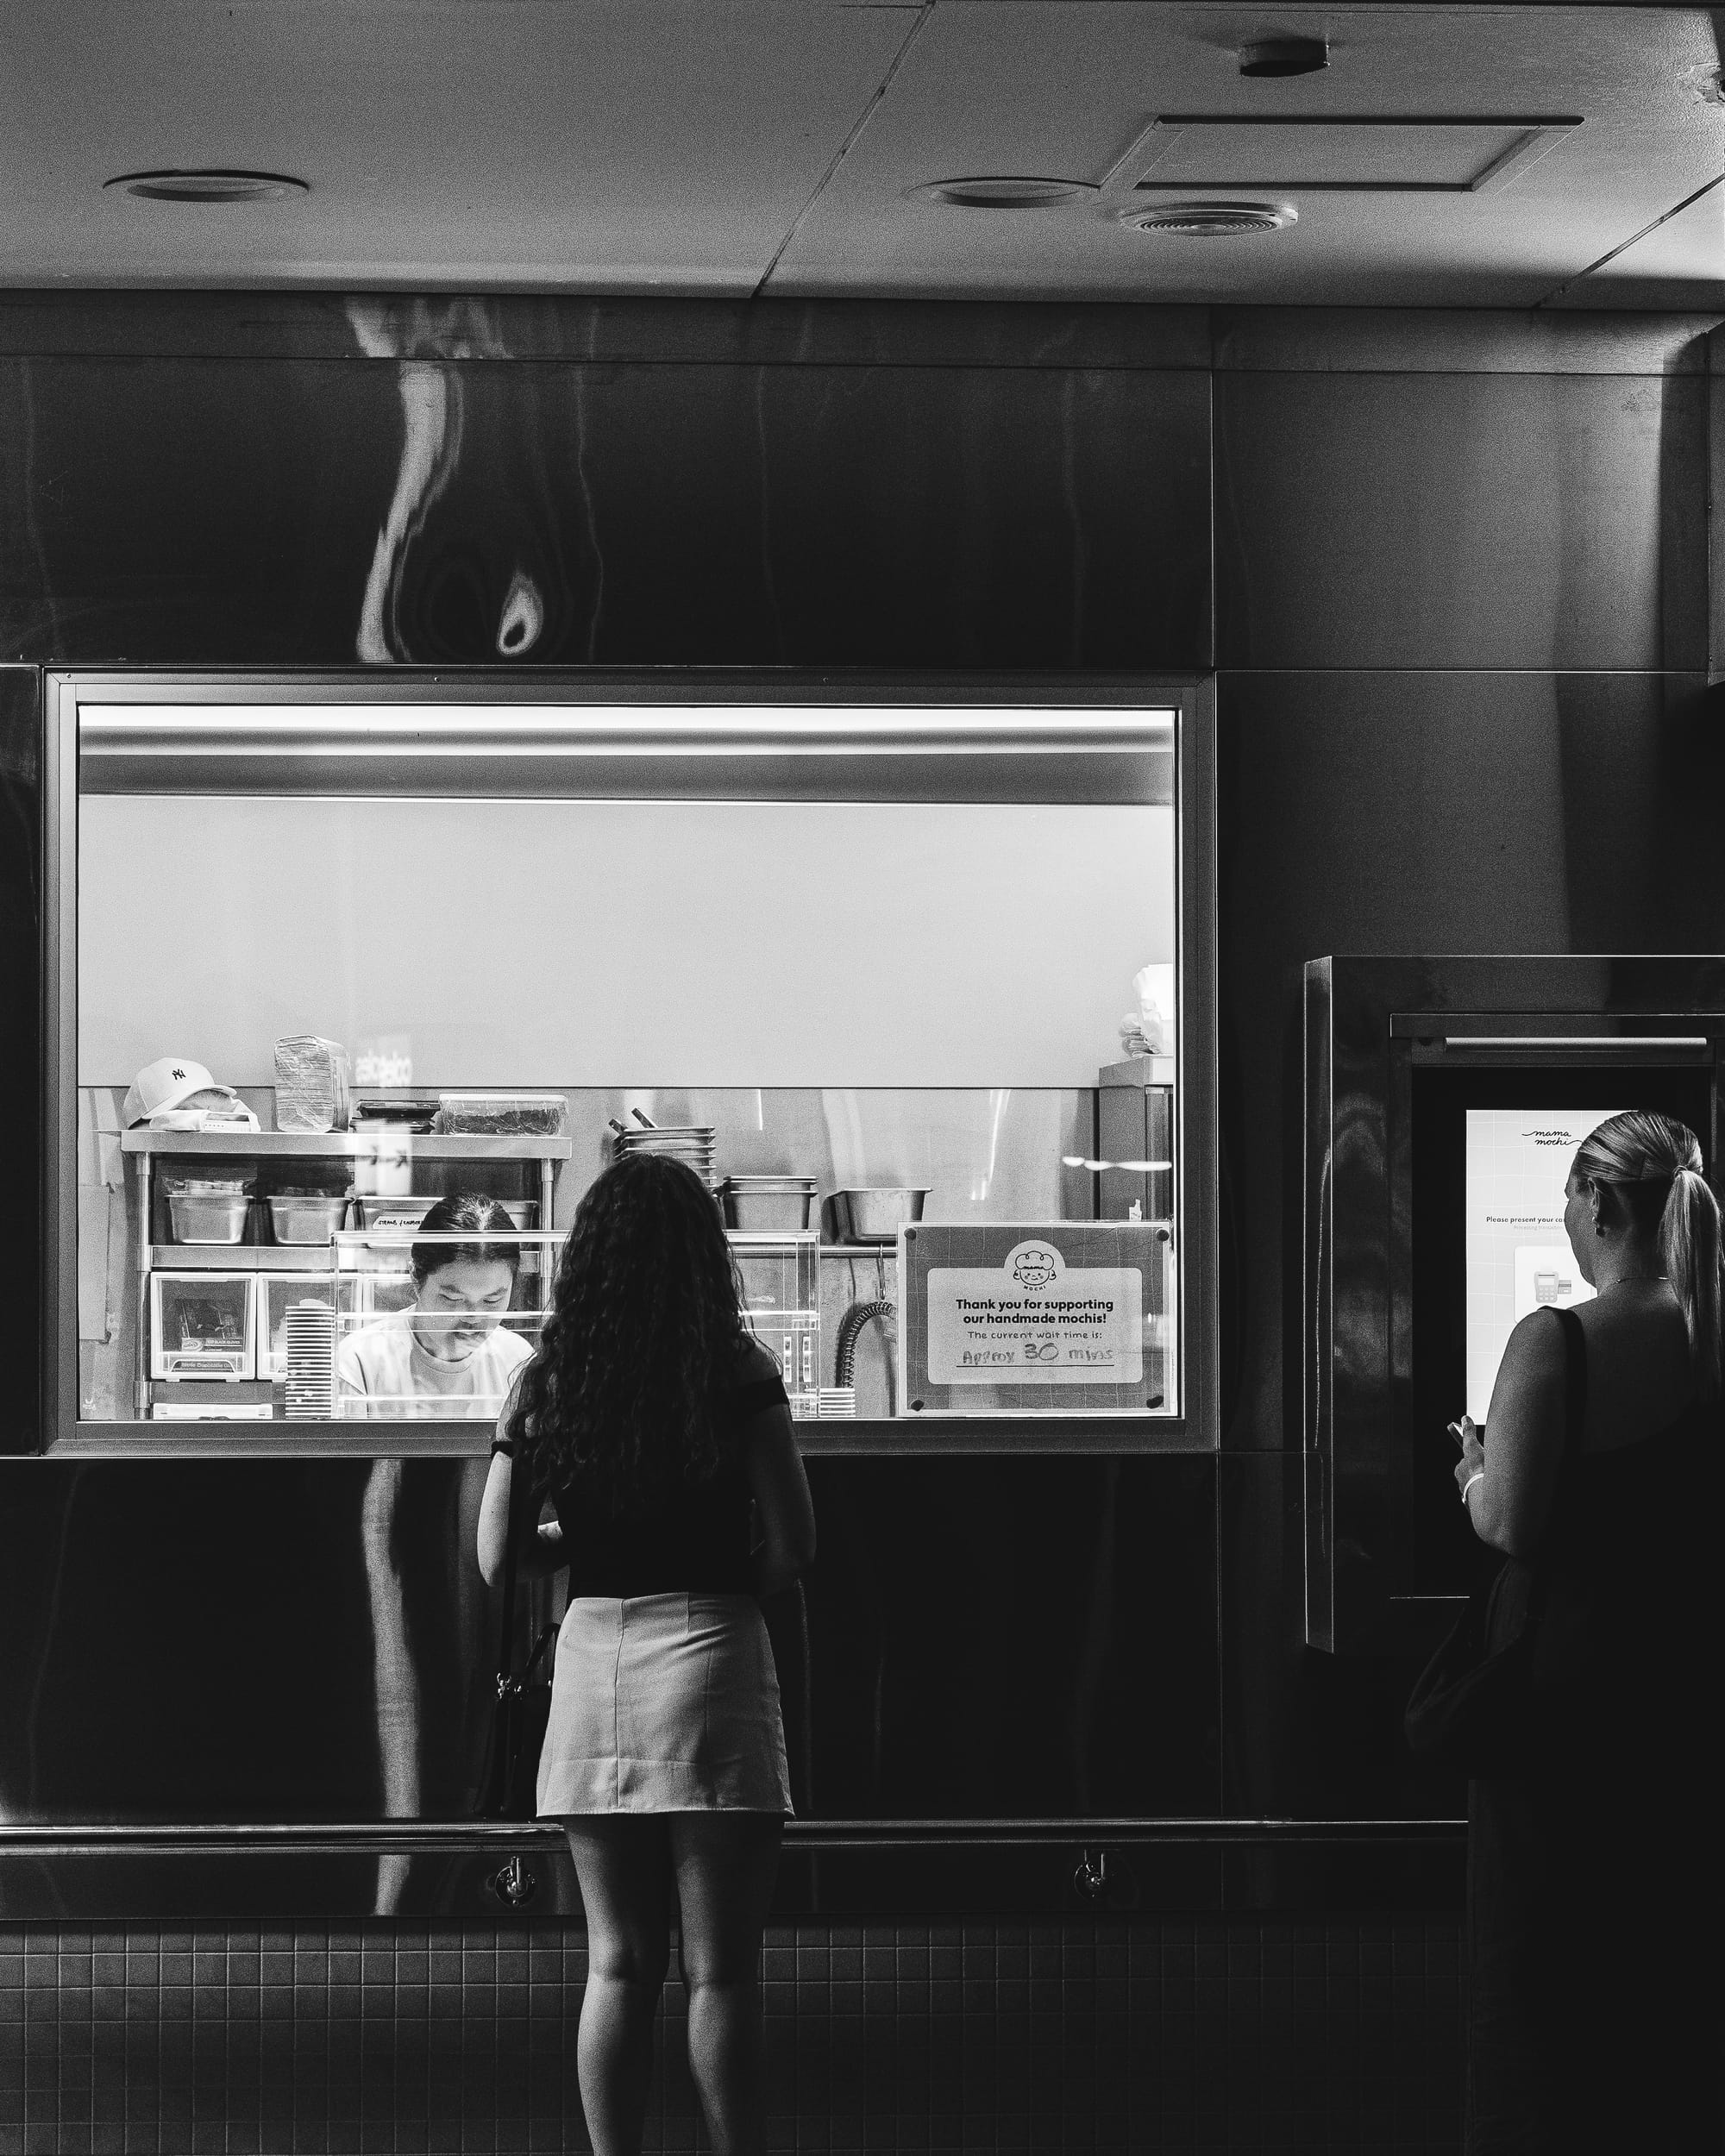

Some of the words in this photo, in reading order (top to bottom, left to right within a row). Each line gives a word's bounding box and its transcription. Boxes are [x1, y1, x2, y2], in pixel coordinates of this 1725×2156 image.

[1534, 1137, 1583, 1145] mochi
[956, 1299, 996, 1310] Thank
[999, 1301, 1022, 1312] you
[1024, 1299, 1043, 1310] for
[1044, 1299, 1113, 1312] supporting
[963, 1315, 984, 1324] our
[987, 1313, 1056, 1324] handmade
[1058, 1313, 1107, 1324] mochis!
[968, 1331, 988, 1339] The
[1025, 1343, 1059, 1361] 30
[1069, 1348, 1113, 1361] mins
